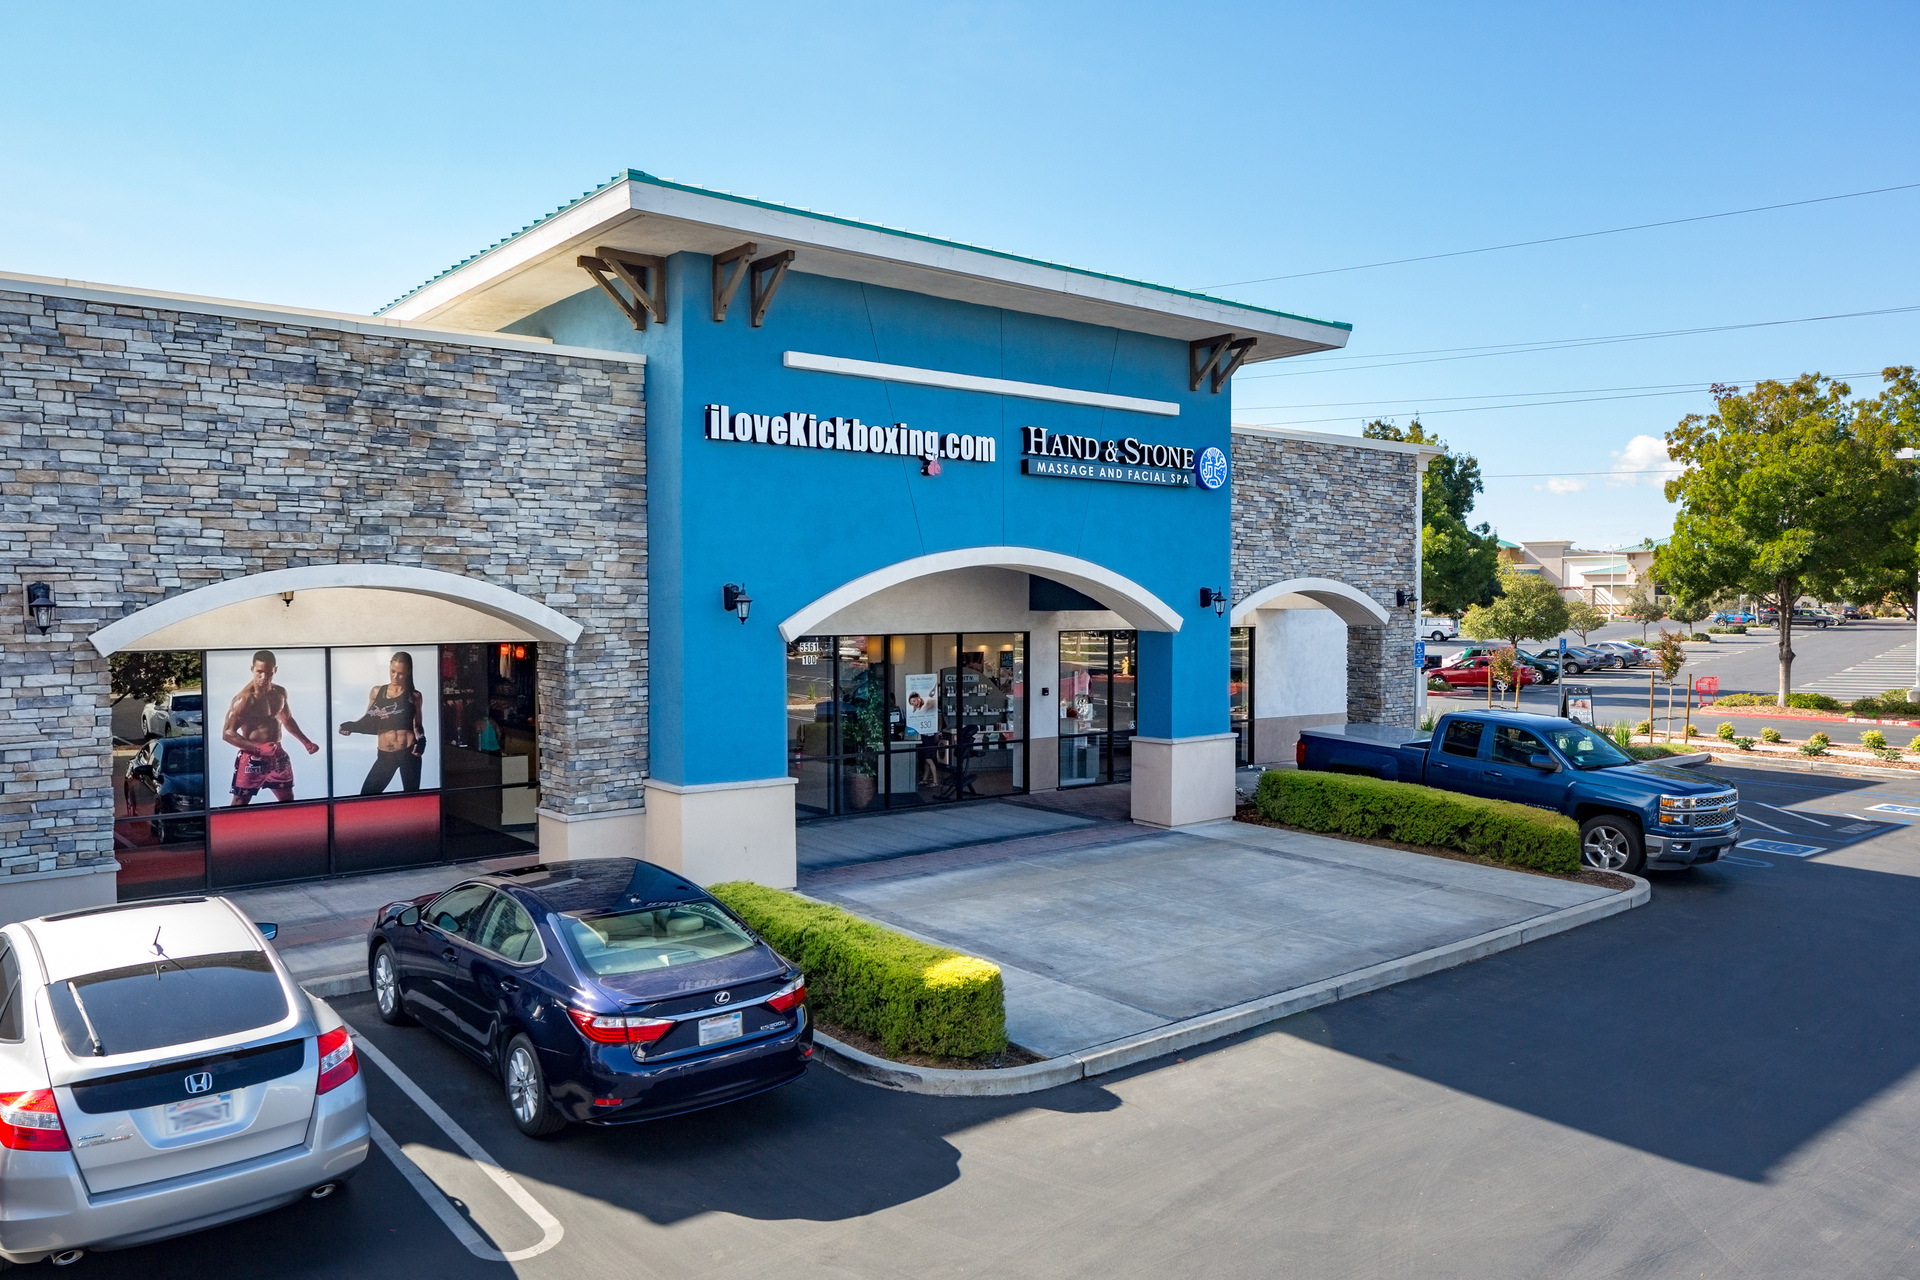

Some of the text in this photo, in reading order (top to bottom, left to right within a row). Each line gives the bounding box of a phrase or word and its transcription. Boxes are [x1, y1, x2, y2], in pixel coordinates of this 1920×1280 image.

[707, 403, 996, 462] iLoveKickboxing.com
[1027, 425, 1196, 469] HAND & STONE
[1036, 462, 1190, 485] MASSAGE AND FACIAL SPA
[799, 642, 818, 652] 5561
[802, 655, 816, 665] 100
[920, 720, 932, 730] $30
